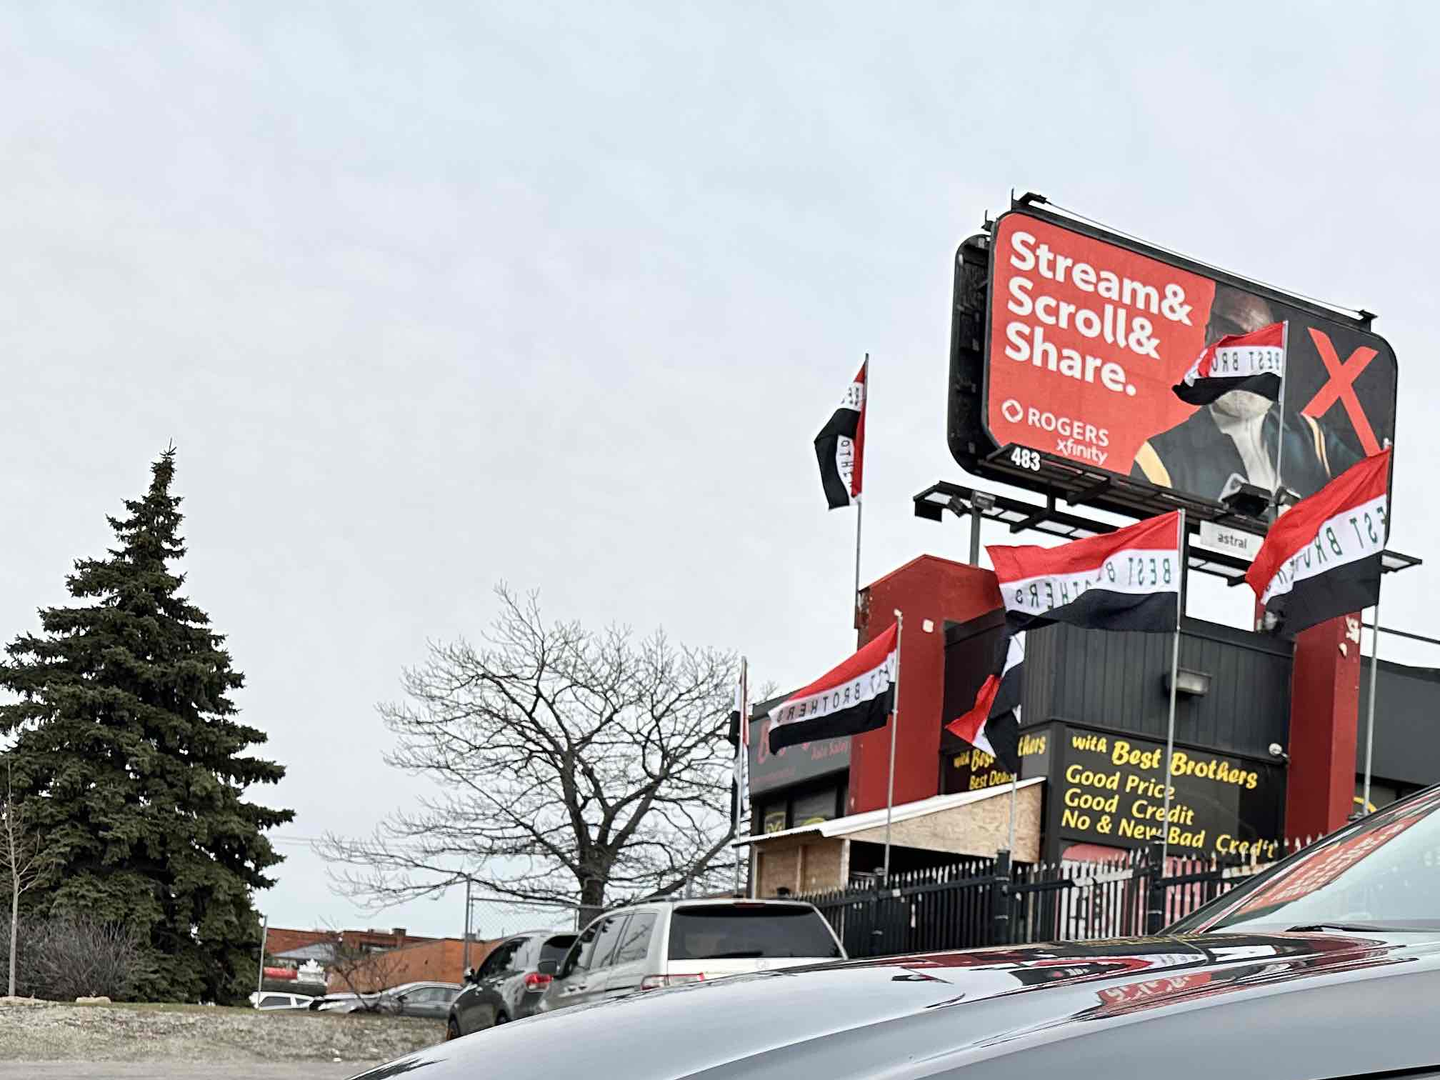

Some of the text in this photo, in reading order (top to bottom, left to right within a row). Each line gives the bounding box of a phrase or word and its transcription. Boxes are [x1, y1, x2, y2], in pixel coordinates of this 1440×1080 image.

[1010, 231, 1192, 327] Stream&
[1006, 277, 1161, 360] Scroll&
[1004, 323, 1137, 397] Share.
[1028, 407, 1109, 447] ROGERS
[1011, 447, 1041, 472] 483
[1056, 438, 1108, 466] xfinity
[1218, 533, 1247, 549] astral
[1018, 734, 1046, 757] thers
[1072, 735, 1258, 789] with Best Brothers
[1065, 764, 1175, 800] Good Price
[1064, 788, 1194, 825] Good Credit
[1061, 809, 1276, 858] No & New Bad Credt
